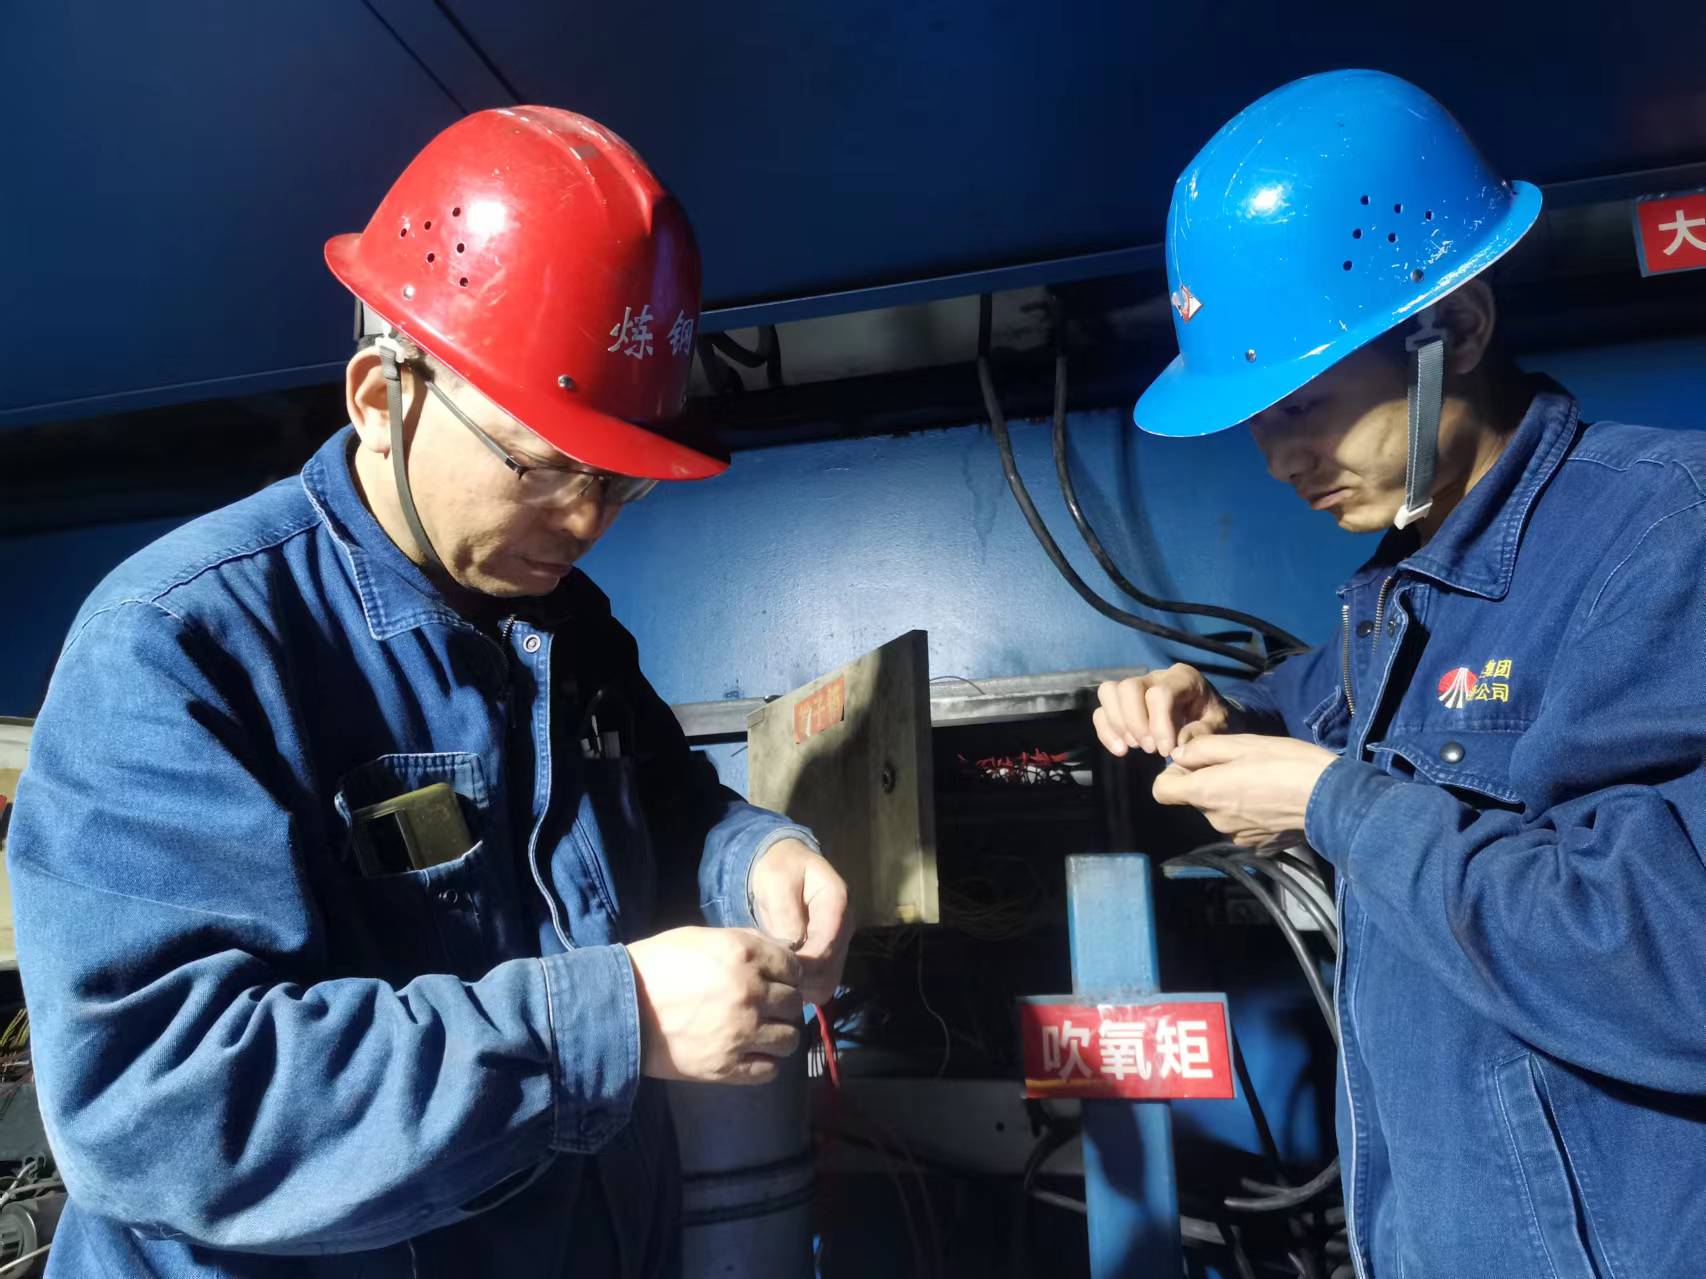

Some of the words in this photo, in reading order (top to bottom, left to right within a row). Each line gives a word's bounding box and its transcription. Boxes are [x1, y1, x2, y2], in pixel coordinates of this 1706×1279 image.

[1658, 210, 1706, 256] 大
[607, 304, 694, 360] 炼钢
[1041, 1019, 1214, 1081] 吹氧矩
